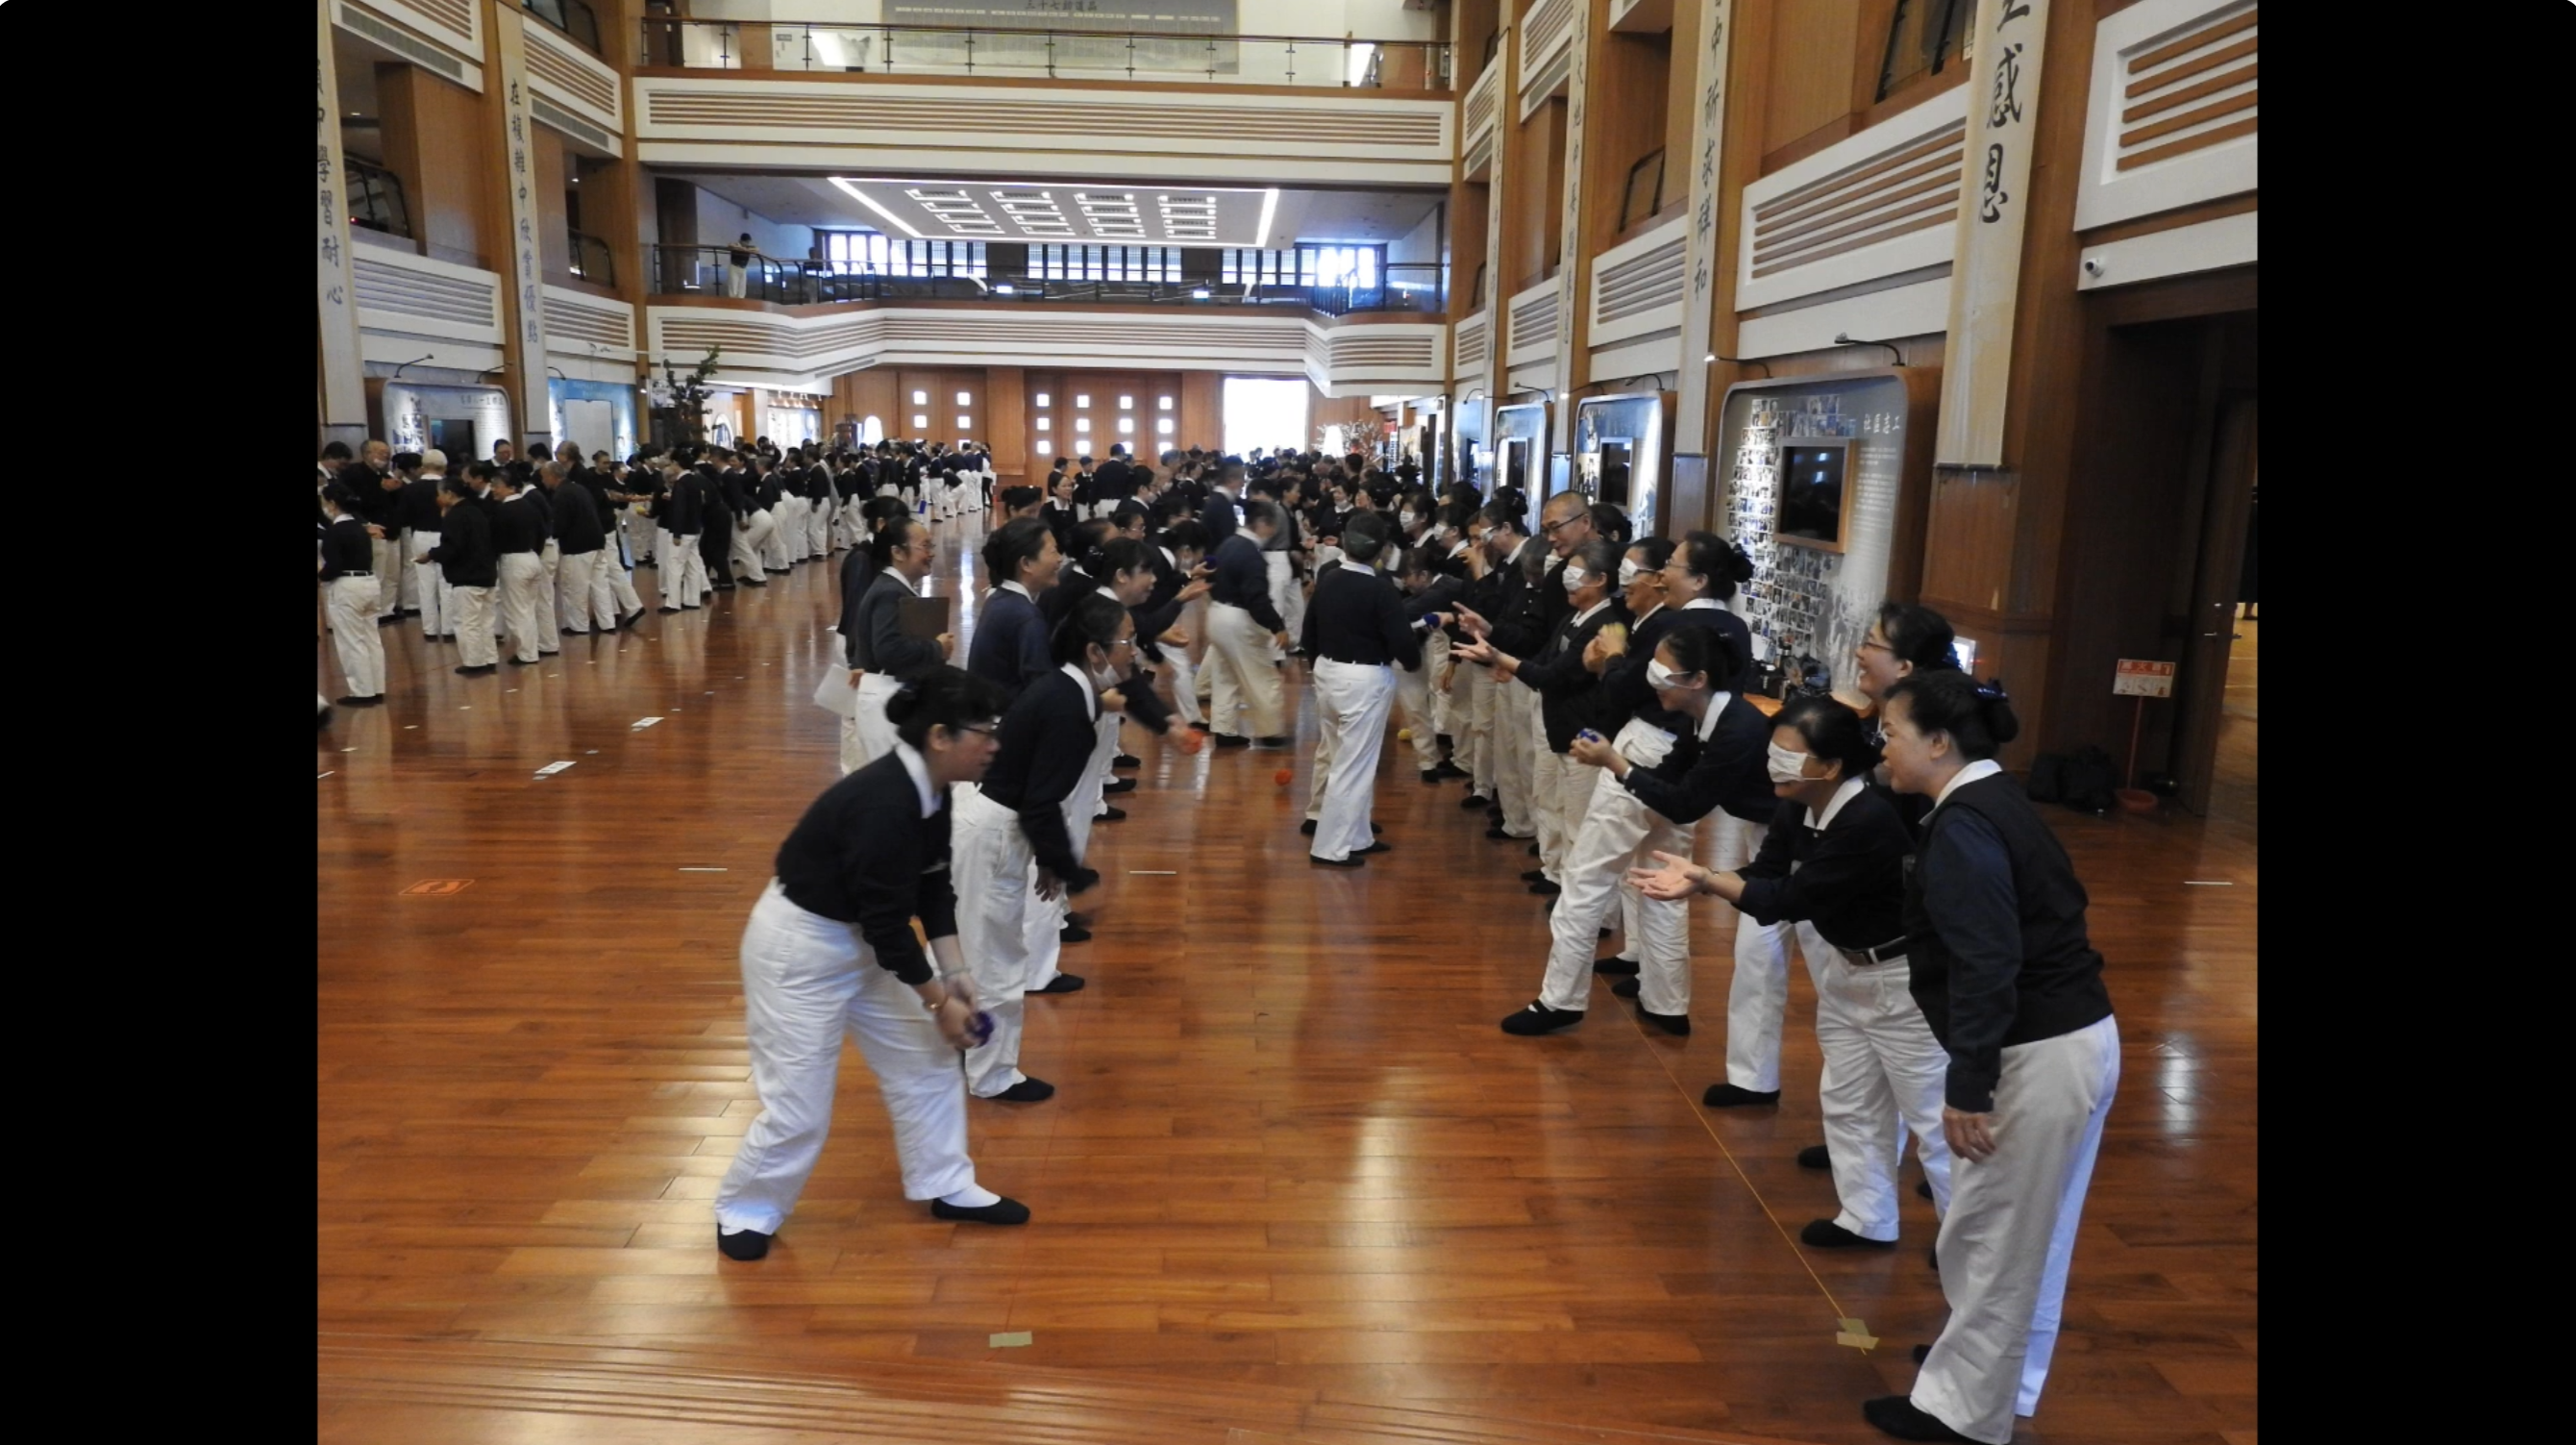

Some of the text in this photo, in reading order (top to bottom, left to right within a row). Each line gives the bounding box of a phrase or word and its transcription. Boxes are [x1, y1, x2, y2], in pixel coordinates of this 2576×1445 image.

[1695, 0, 1722, 302] 中祈求祥和
